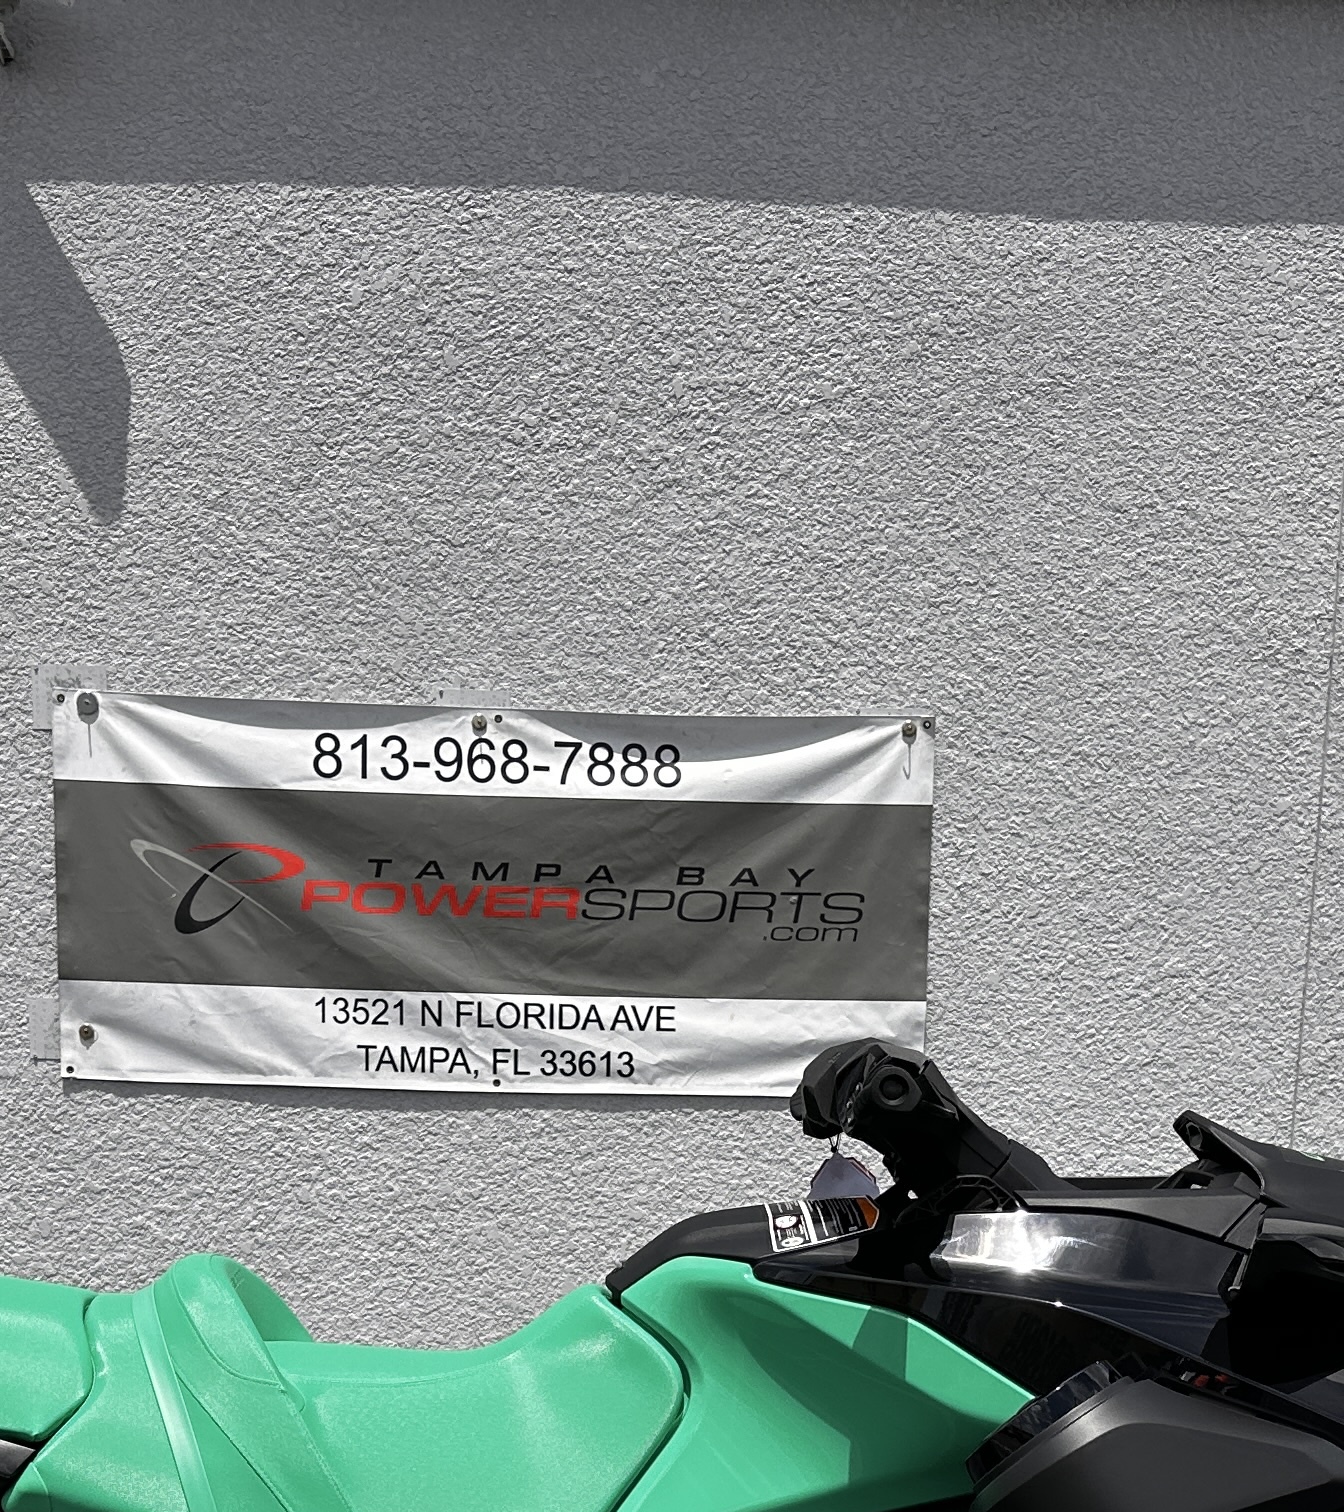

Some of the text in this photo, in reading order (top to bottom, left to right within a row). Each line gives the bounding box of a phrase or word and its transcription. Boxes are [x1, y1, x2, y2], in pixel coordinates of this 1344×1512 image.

[312, 732, 682, 788] 813-968-7888
[367, 858, 815, 888] TAMPA BAY
[300, 879, 865, 925] POWERSPORTS
[763, 926, 858, 942] .com
[314, 996, 677, 1032] 13521 N FLORIDA AVE
[356, 1044, 635, 1079] TAMPA, FL 33613
